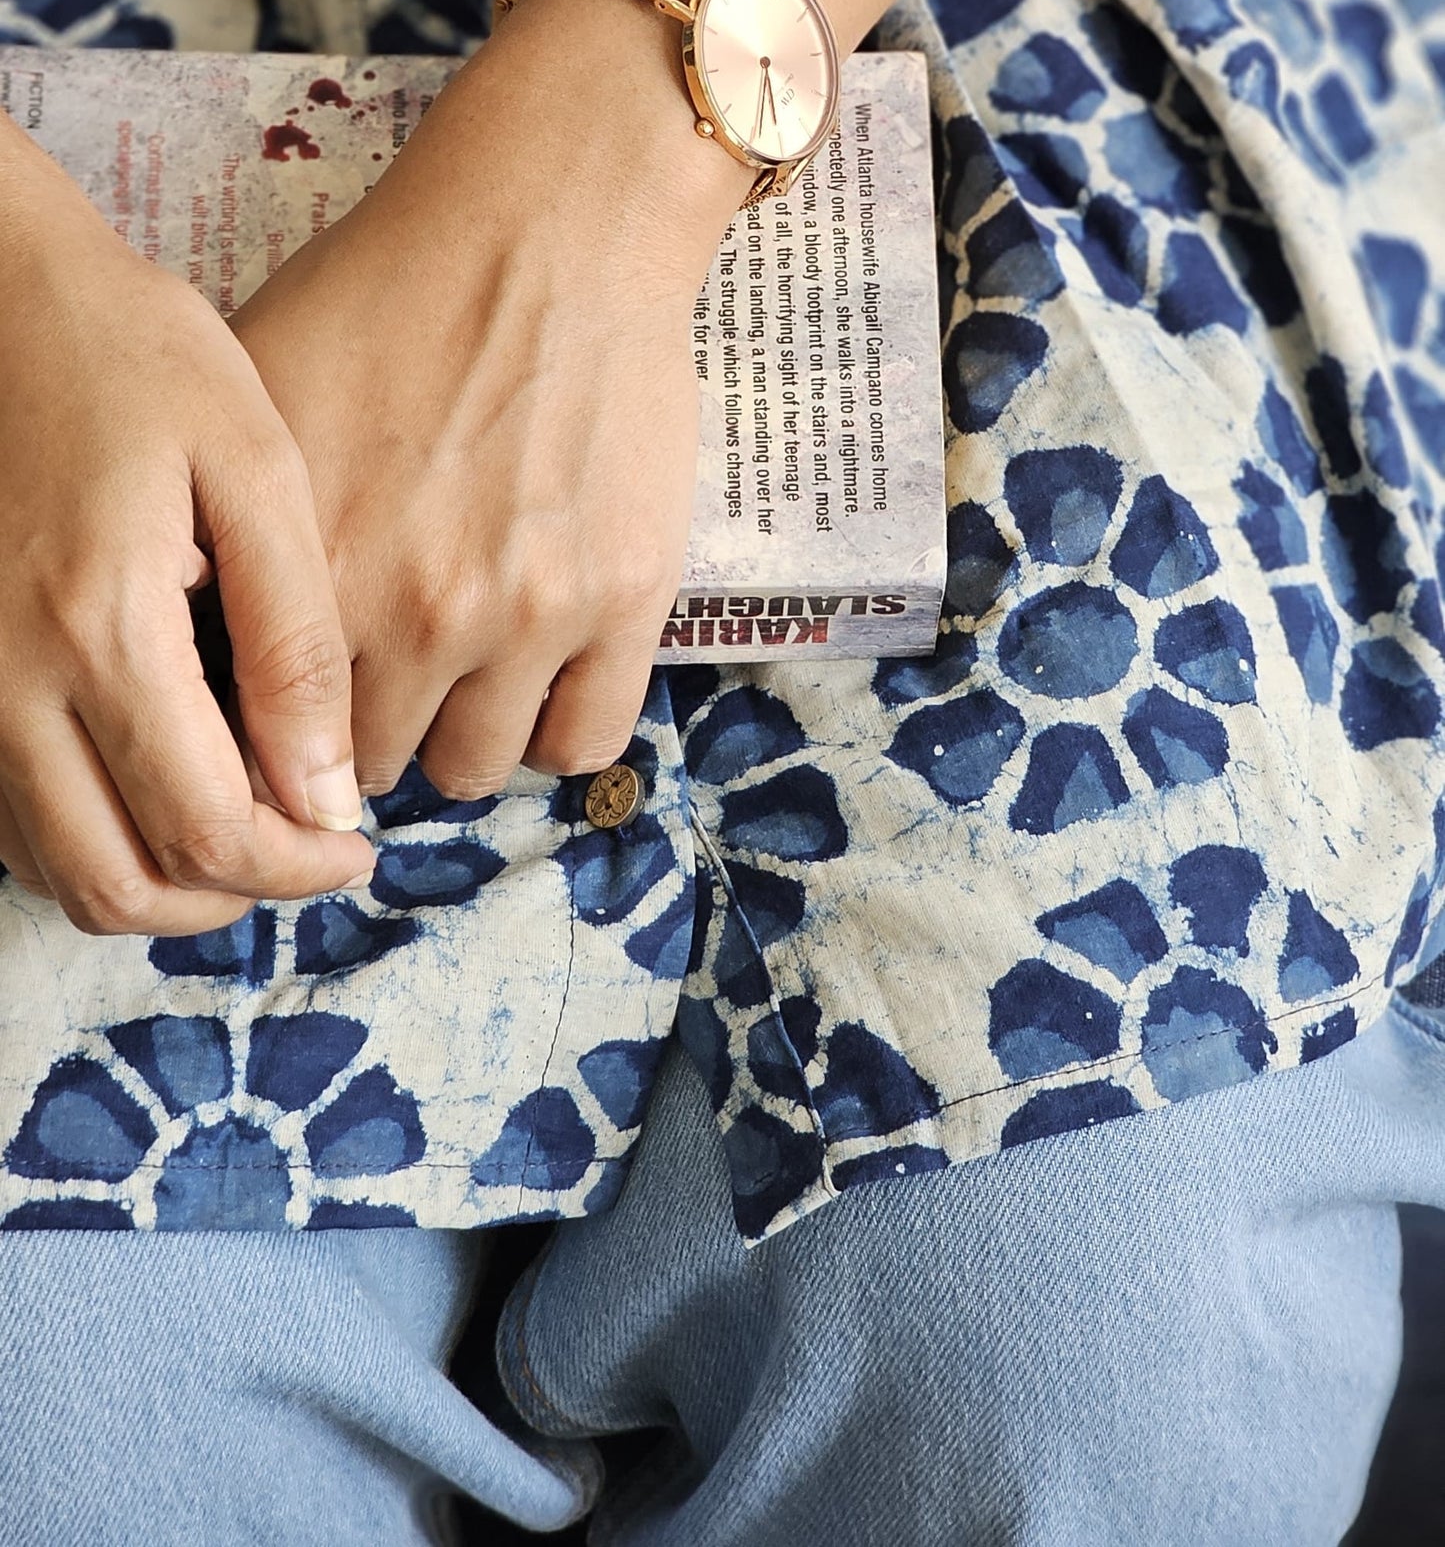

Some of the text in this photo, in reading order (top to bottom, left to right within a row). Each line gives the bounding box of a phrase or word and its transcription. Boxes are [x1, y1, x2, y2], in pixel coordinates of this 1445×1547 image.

[27, 72, 44, 130] FICTION
[392, 88, 409, 149] who has
[217, 185, 238, 234] writing
[311, 192, 330, 234] Prais
[804, 219, 818, 229] a
[830, 196, 846, 222] one
[143, 224, 161, 239] at
[187, 194, 209, 285] will blow you
[220, 237, 237, 250] is
[719, 248, 738, 276] The
[802, 233, 823, 282] bloody
[832, 228, 850, 301] afternoon,
[219, 285, 237, 312] and
[692, 297, 711, 320] life
[718, 280, 740, 340] struggle
[804, 286, 826, 349] footprint
[836, 306, 853, 332] she
[855, 103, 889, 511] When Atlanta housewife Abigail Campano comes home
[693, 325, 711, 345] for
[772, 202, 801, 502] of all, the horrifying sight of her teenage
[694, 349, 709, 381] ever
[722, 344, 742, 389] which
[746, 205, 775, 535] ead on the landing, a man standing over her
[809, 354, 824, 371] on
[837, 336, 856, 381] walks
[811, 376, 828, 401] the
[839, 386, 857, 414] into
[724, 392, 742, 448] follows
[811, 405, 830, 448] stairs
[841, 419, 855, 428] a
[724, 452, 744, 519] changes
[811, 453, 832, 486] and,
[838, 433, 860, 518] nightmare.
[815, 492, 833, 533] most
[668, 594, 907, 619] SLAUGHT
[659, 616, 830, 648] KARIN
